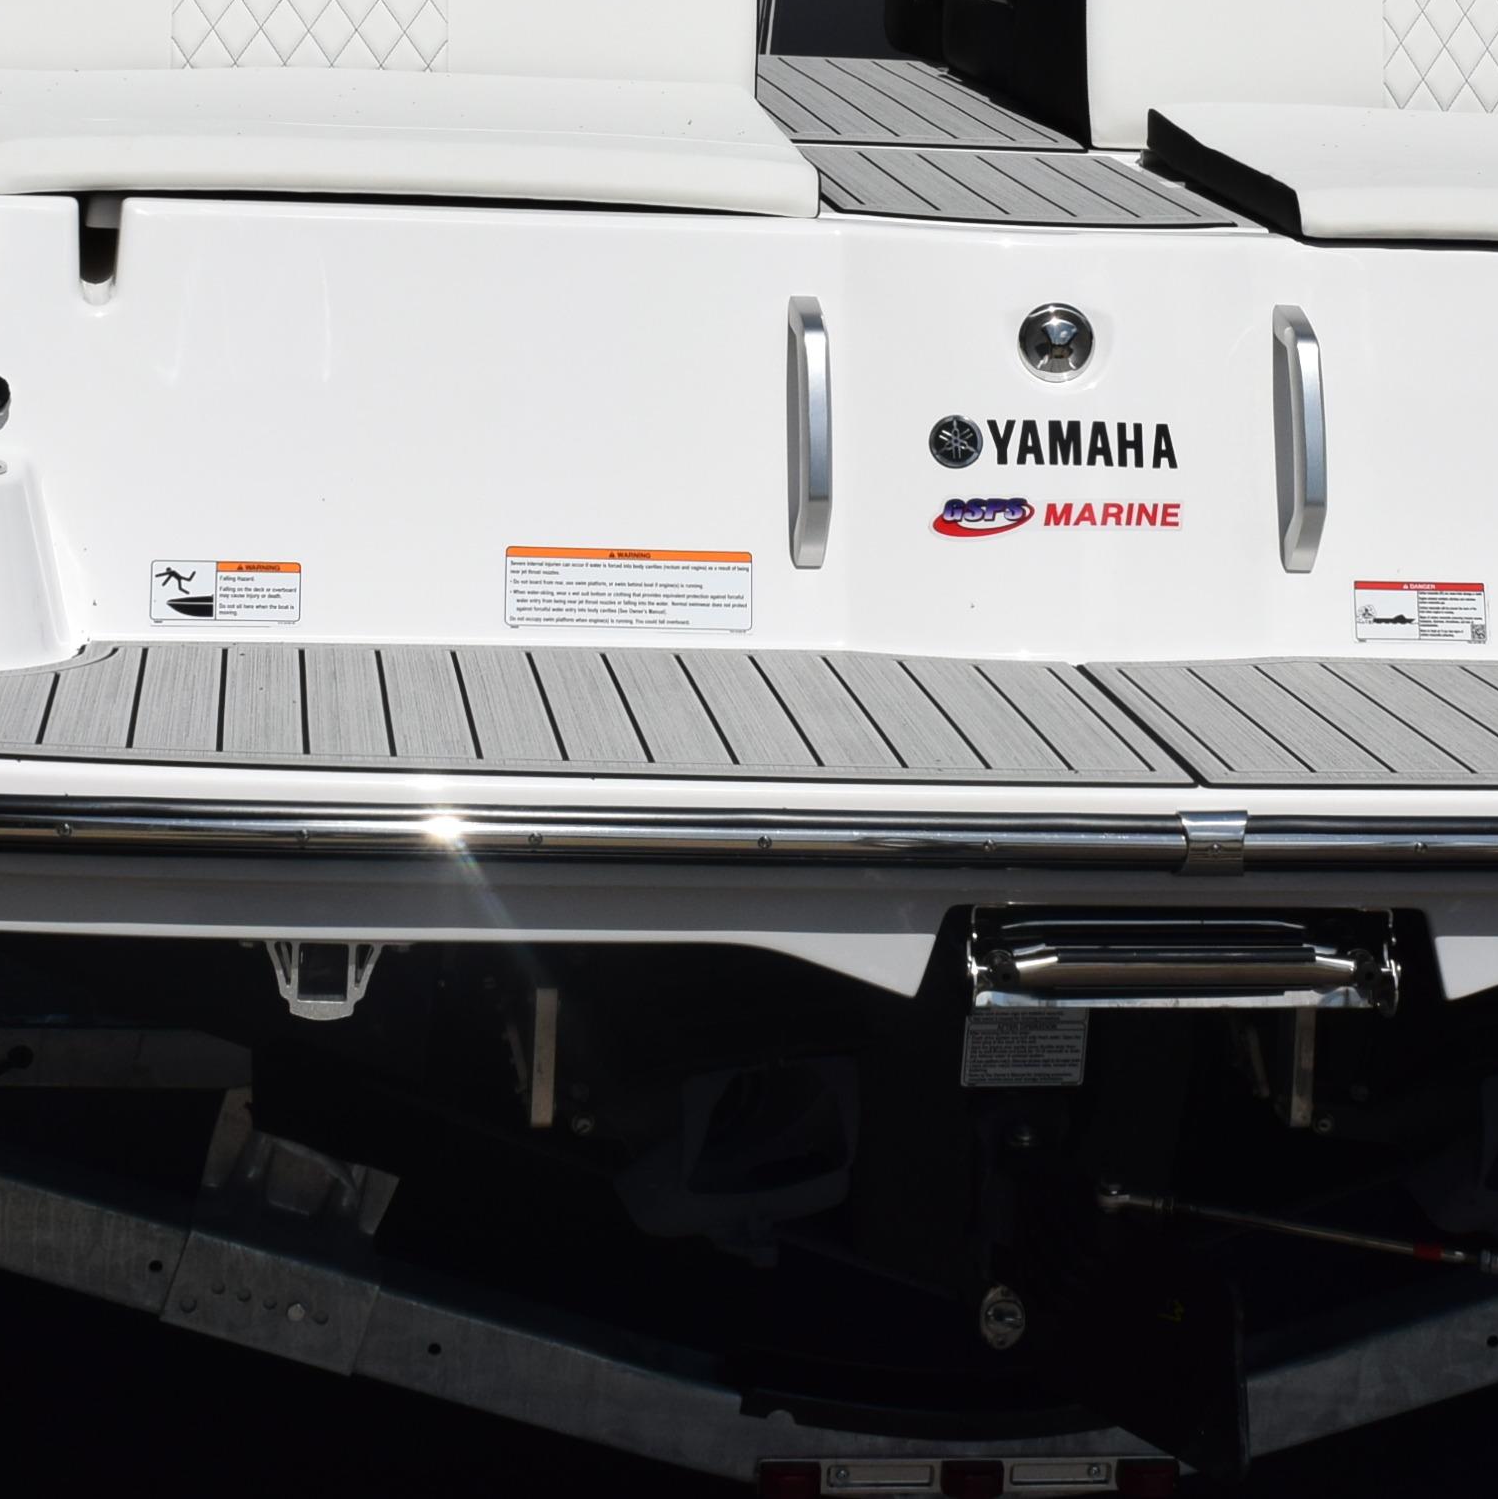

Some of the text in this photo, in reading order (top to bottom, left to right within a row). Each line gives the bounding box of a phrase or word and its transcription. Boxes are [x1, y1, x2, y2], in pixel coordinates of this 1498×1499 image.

[986, 419, 1178, 469] YAMAHA
[943, 497, 1181, 527] GSPS MARINE
